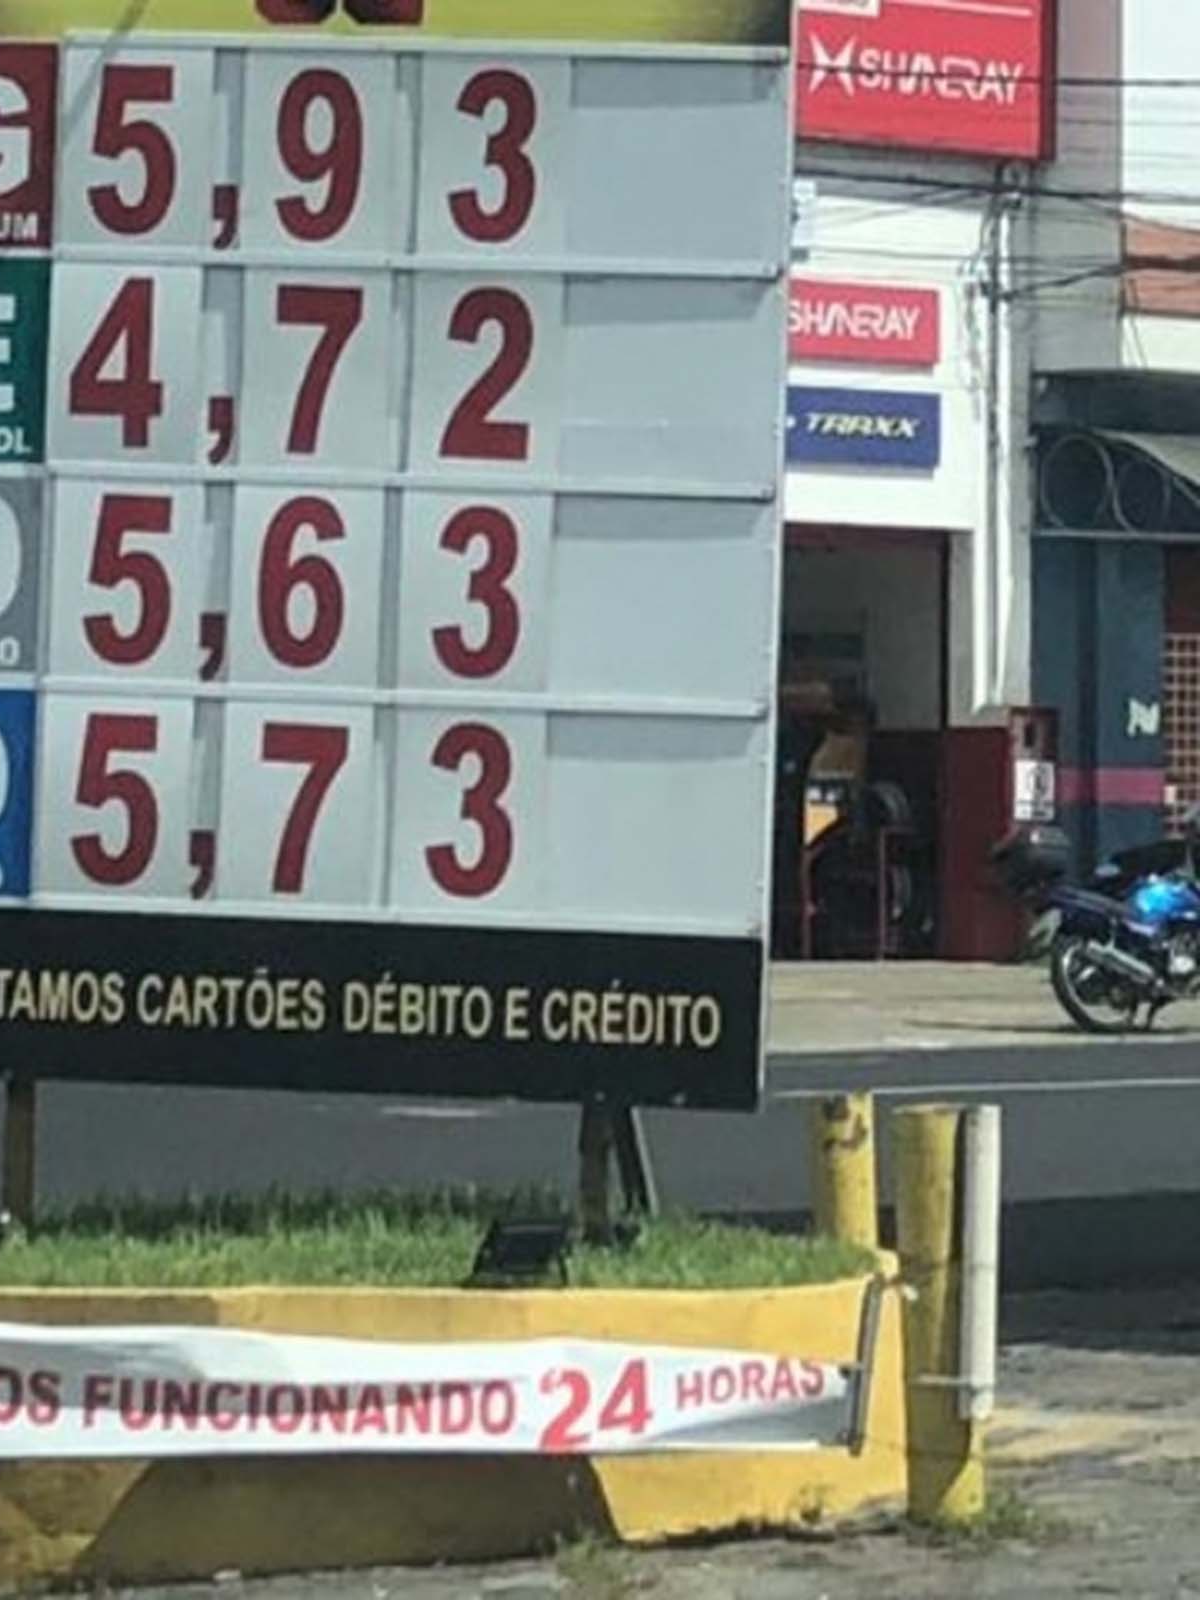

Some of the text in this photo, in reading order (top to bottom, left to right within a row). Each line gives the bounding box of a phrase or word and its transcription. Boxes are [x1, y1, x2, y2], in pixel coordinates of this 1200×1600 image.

[87, 63, 538, 249] 5,93
[68, 276, 535, 466] 4,72
[82, 493, 522, 681] 5,63
[69, 712, 514, 902] 5,73
[136, 966, 327, 1032] CARTÕES
[342, 971, 492, 1040] DÉBITO
[505, 987, 530, 1040] E
[541, 979, 721, 1049] CRÉDITO
[83, 1374, 516, 1435] FUNCIONANDO
[676, 1359, 826, 1410] HORAS
